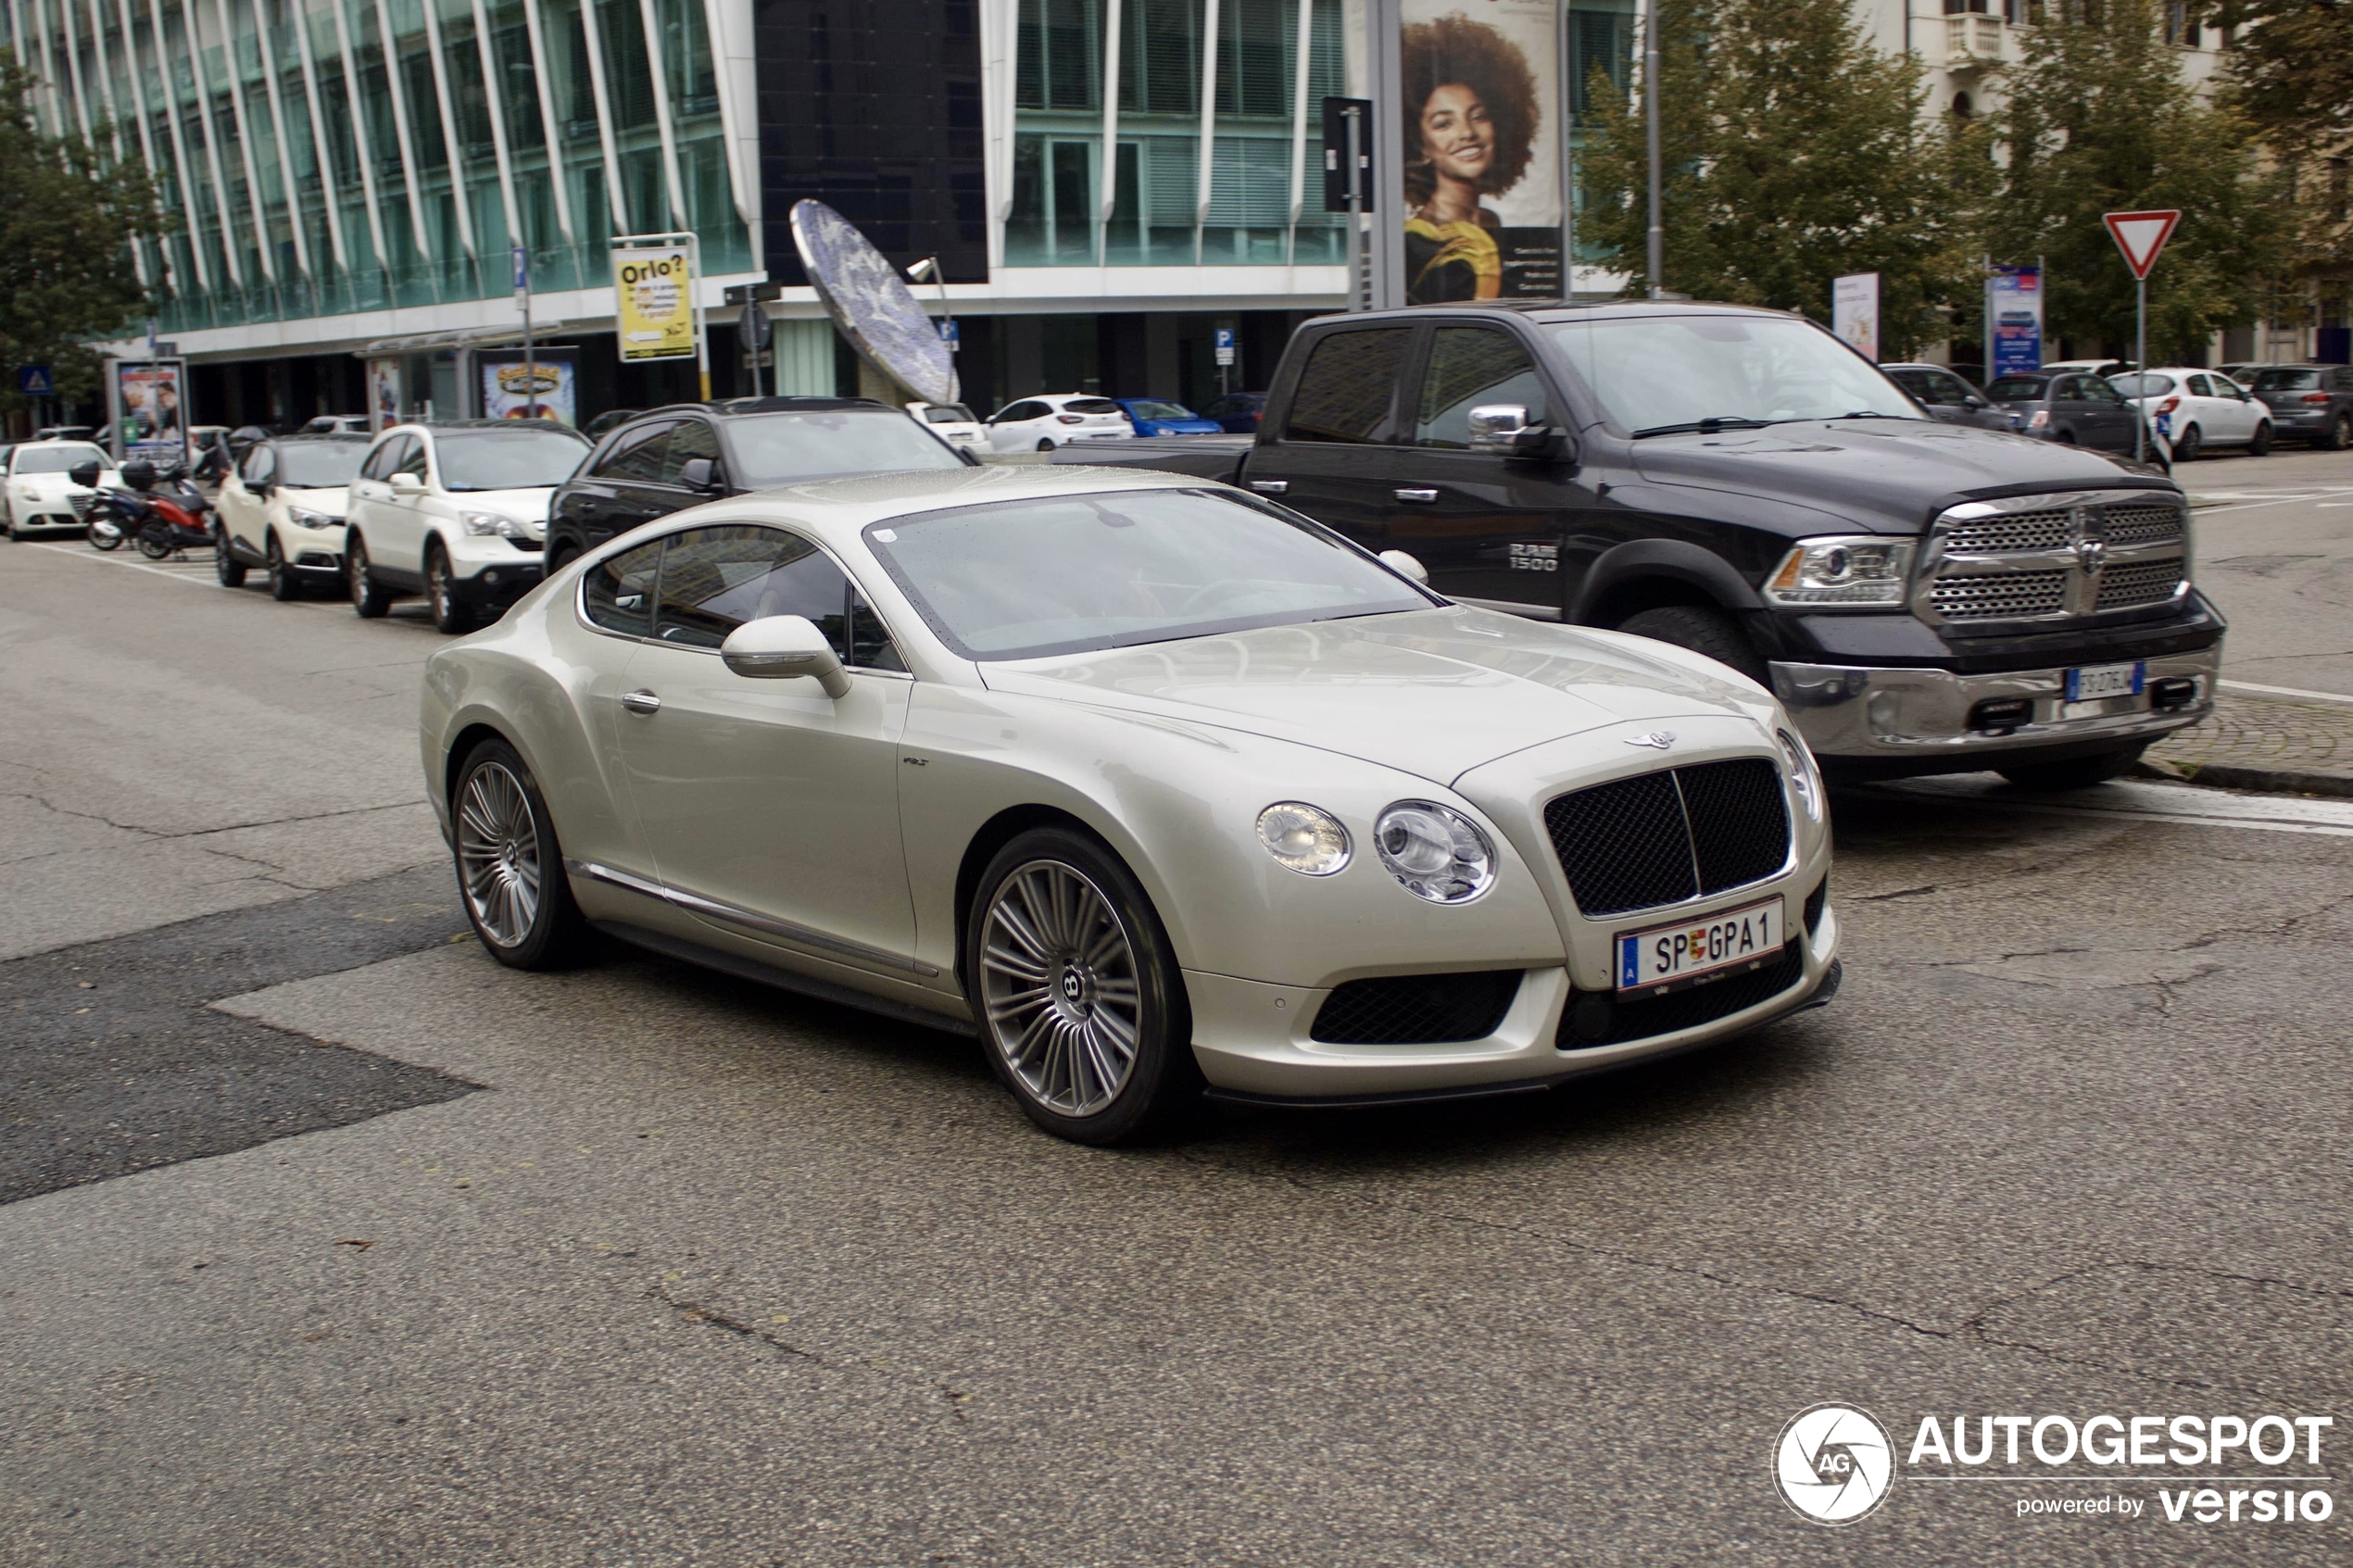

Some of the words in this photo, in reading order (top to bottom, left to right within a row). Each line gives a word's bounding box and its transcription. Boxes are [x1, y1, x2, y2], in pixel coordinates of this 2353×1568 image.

[622, 254, 683, 283] Orlo?
[1217, 331, 1231, 346] P
[1509, 557, 1558, 571] 1500
[1656, 934, 1688, 972] SP
[1626, 968, 1635, 980] A
